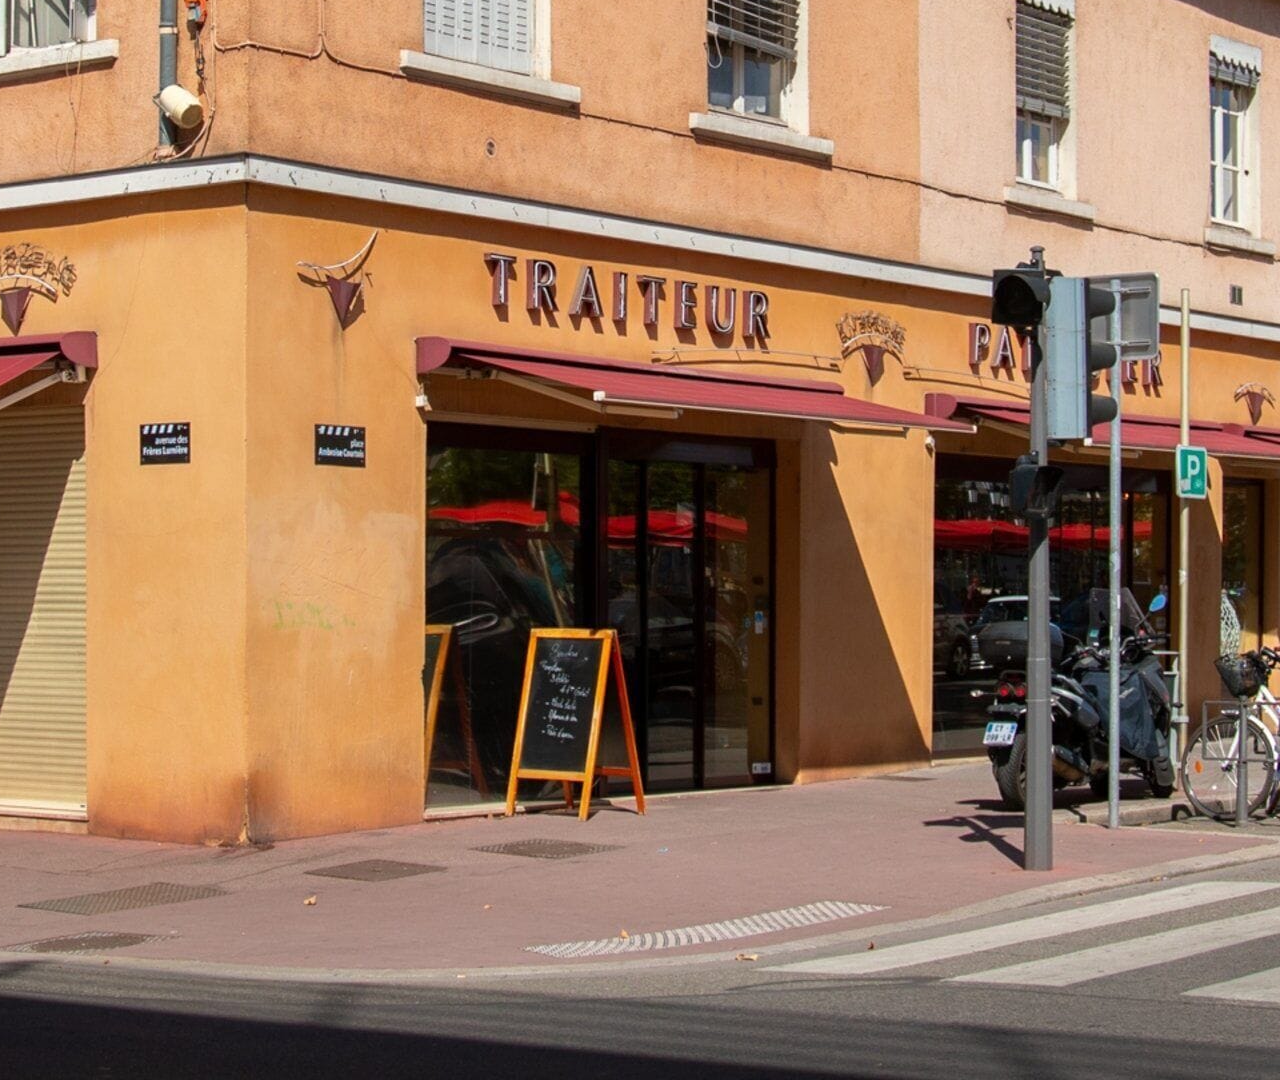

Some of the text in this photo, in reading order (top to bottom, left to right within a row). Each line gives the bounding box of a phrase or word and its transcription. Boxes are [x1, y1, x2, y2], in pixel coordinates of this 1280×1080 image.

[483, 252, 770, 339] TRAITEUR
[177, 435, 188, 444] des
[1187, 454, 1200, 489] P
